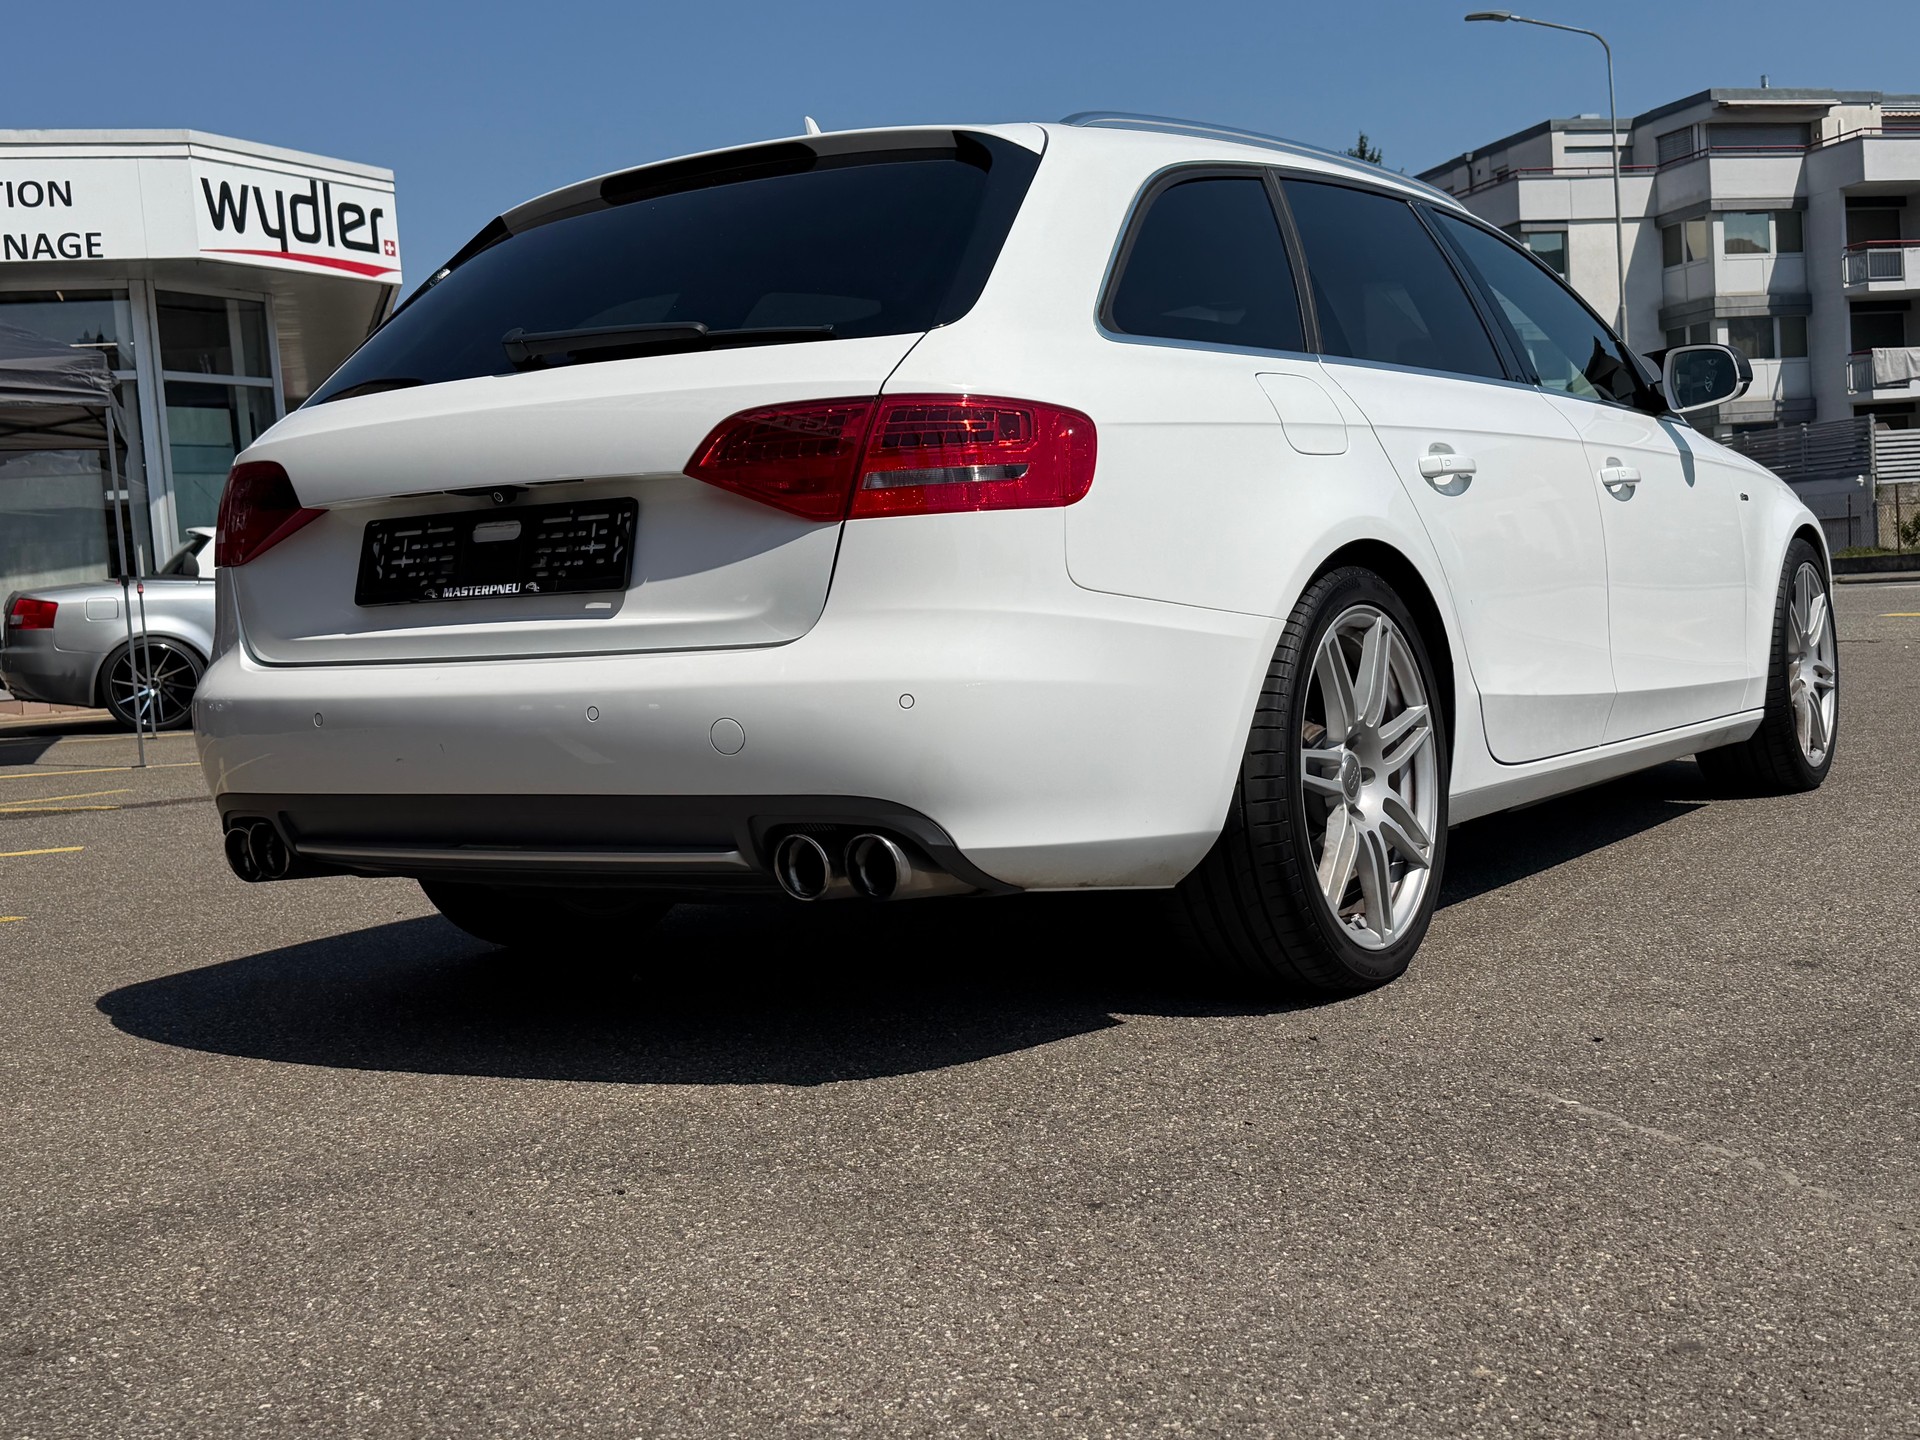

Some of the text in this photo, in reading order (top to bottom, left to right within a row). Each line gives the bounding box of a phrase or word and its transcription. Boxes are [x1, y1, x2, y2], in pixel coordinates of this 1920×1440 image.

[0, 180, 72, 208] ION
[200, 177, 384, 254] wydler
[3, 232, 104, 260] NAGE
[442, 582, 521, 598] MASTERPNEU
